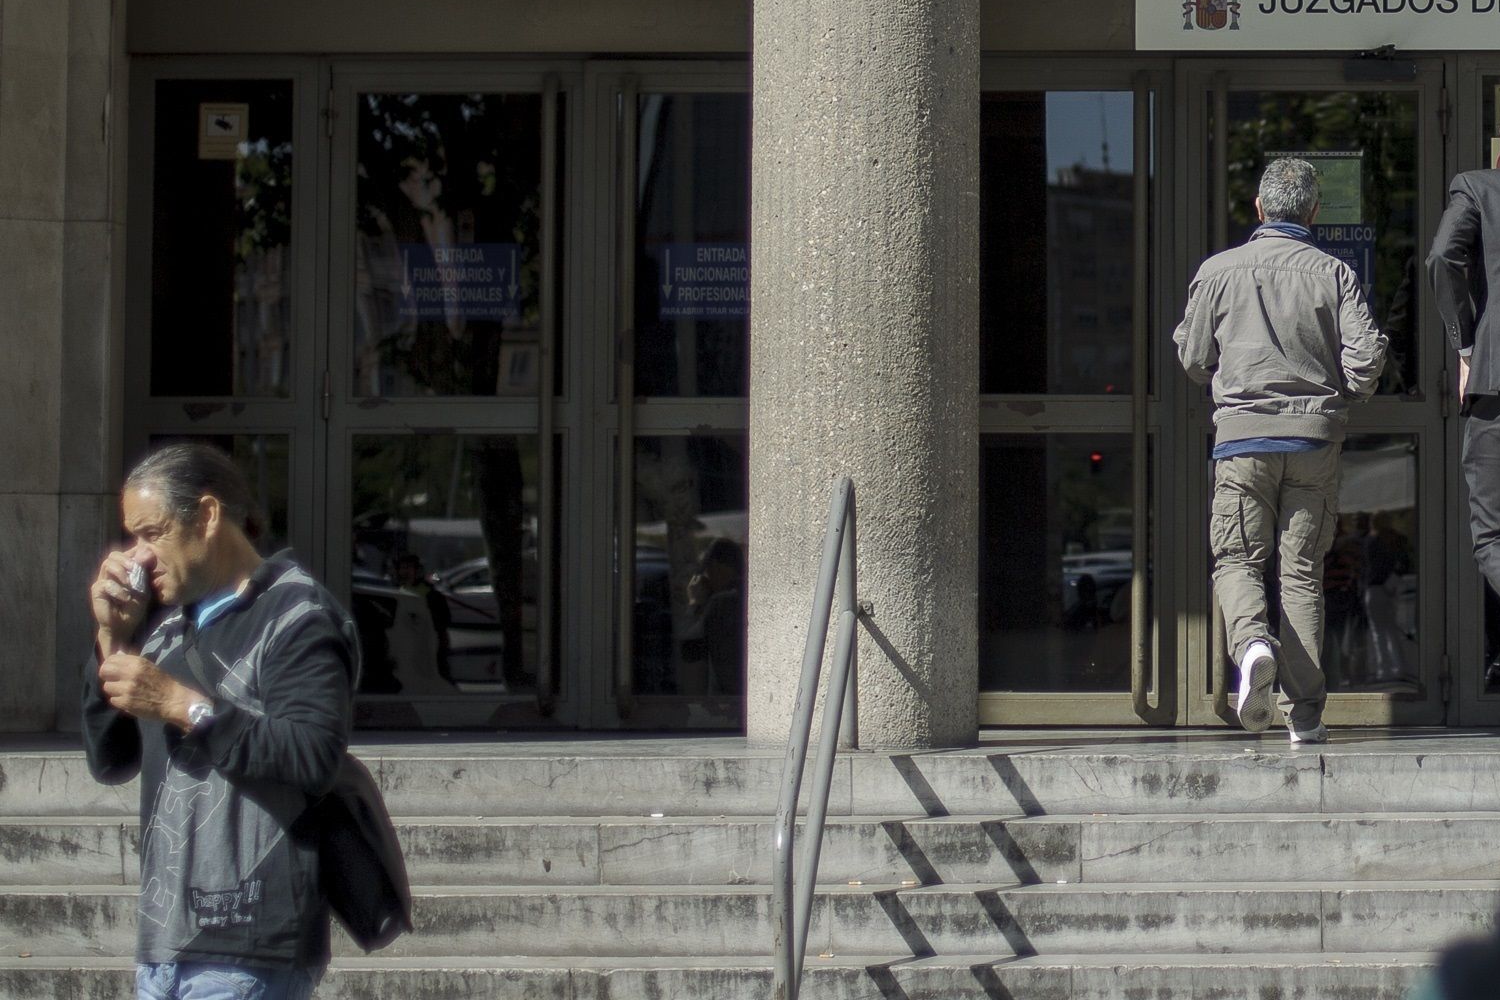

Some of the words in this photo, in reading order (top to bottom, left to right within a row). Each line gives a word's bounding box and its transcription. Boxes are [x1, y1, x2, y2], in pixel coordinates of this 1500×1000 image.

[434, 249, 485, 263] ENTRADA
[696, 248, 746, 262] ENTRADA
[413, 268, 493, 281] FUNCIONARIOS
[498, 268, 506, 281] Y
[675, 267, 749, 281] FUNCIONARIO
[416, 288, 503, 301] PROFESIONALES
[678, 287, 750, 301] PROFESIONAL
